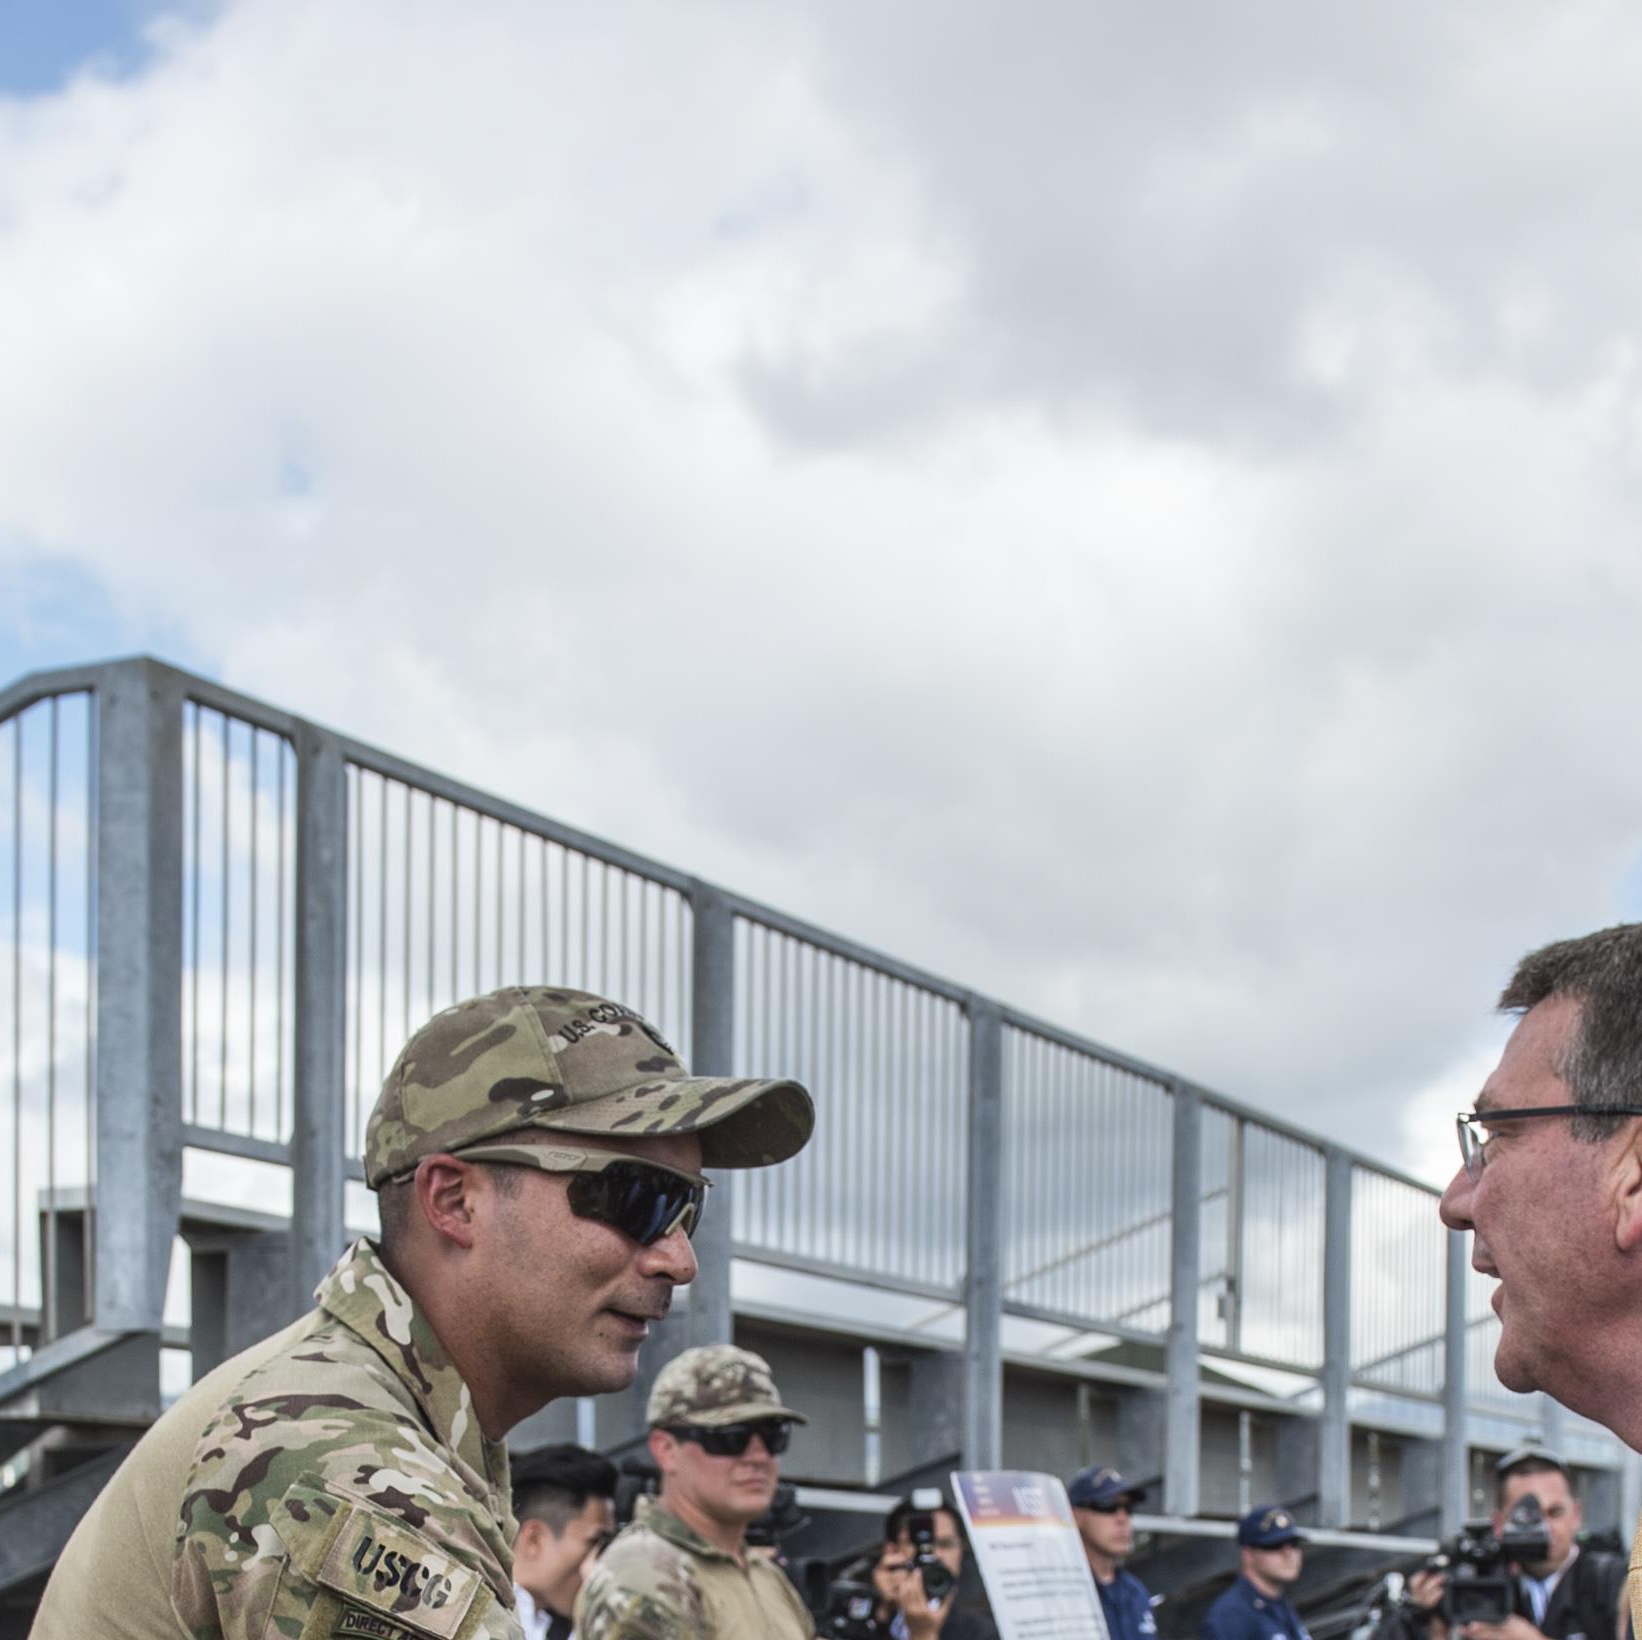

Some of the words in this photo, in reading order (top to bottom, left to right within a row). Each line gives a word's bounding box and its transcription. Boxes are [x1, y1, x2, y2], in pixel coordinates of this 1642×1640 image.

[559, 1019, 596, 1044] U.S.
[352, 1536, 452, 1609] USCG
[345, 1614, 395, 1638] DIRECT
